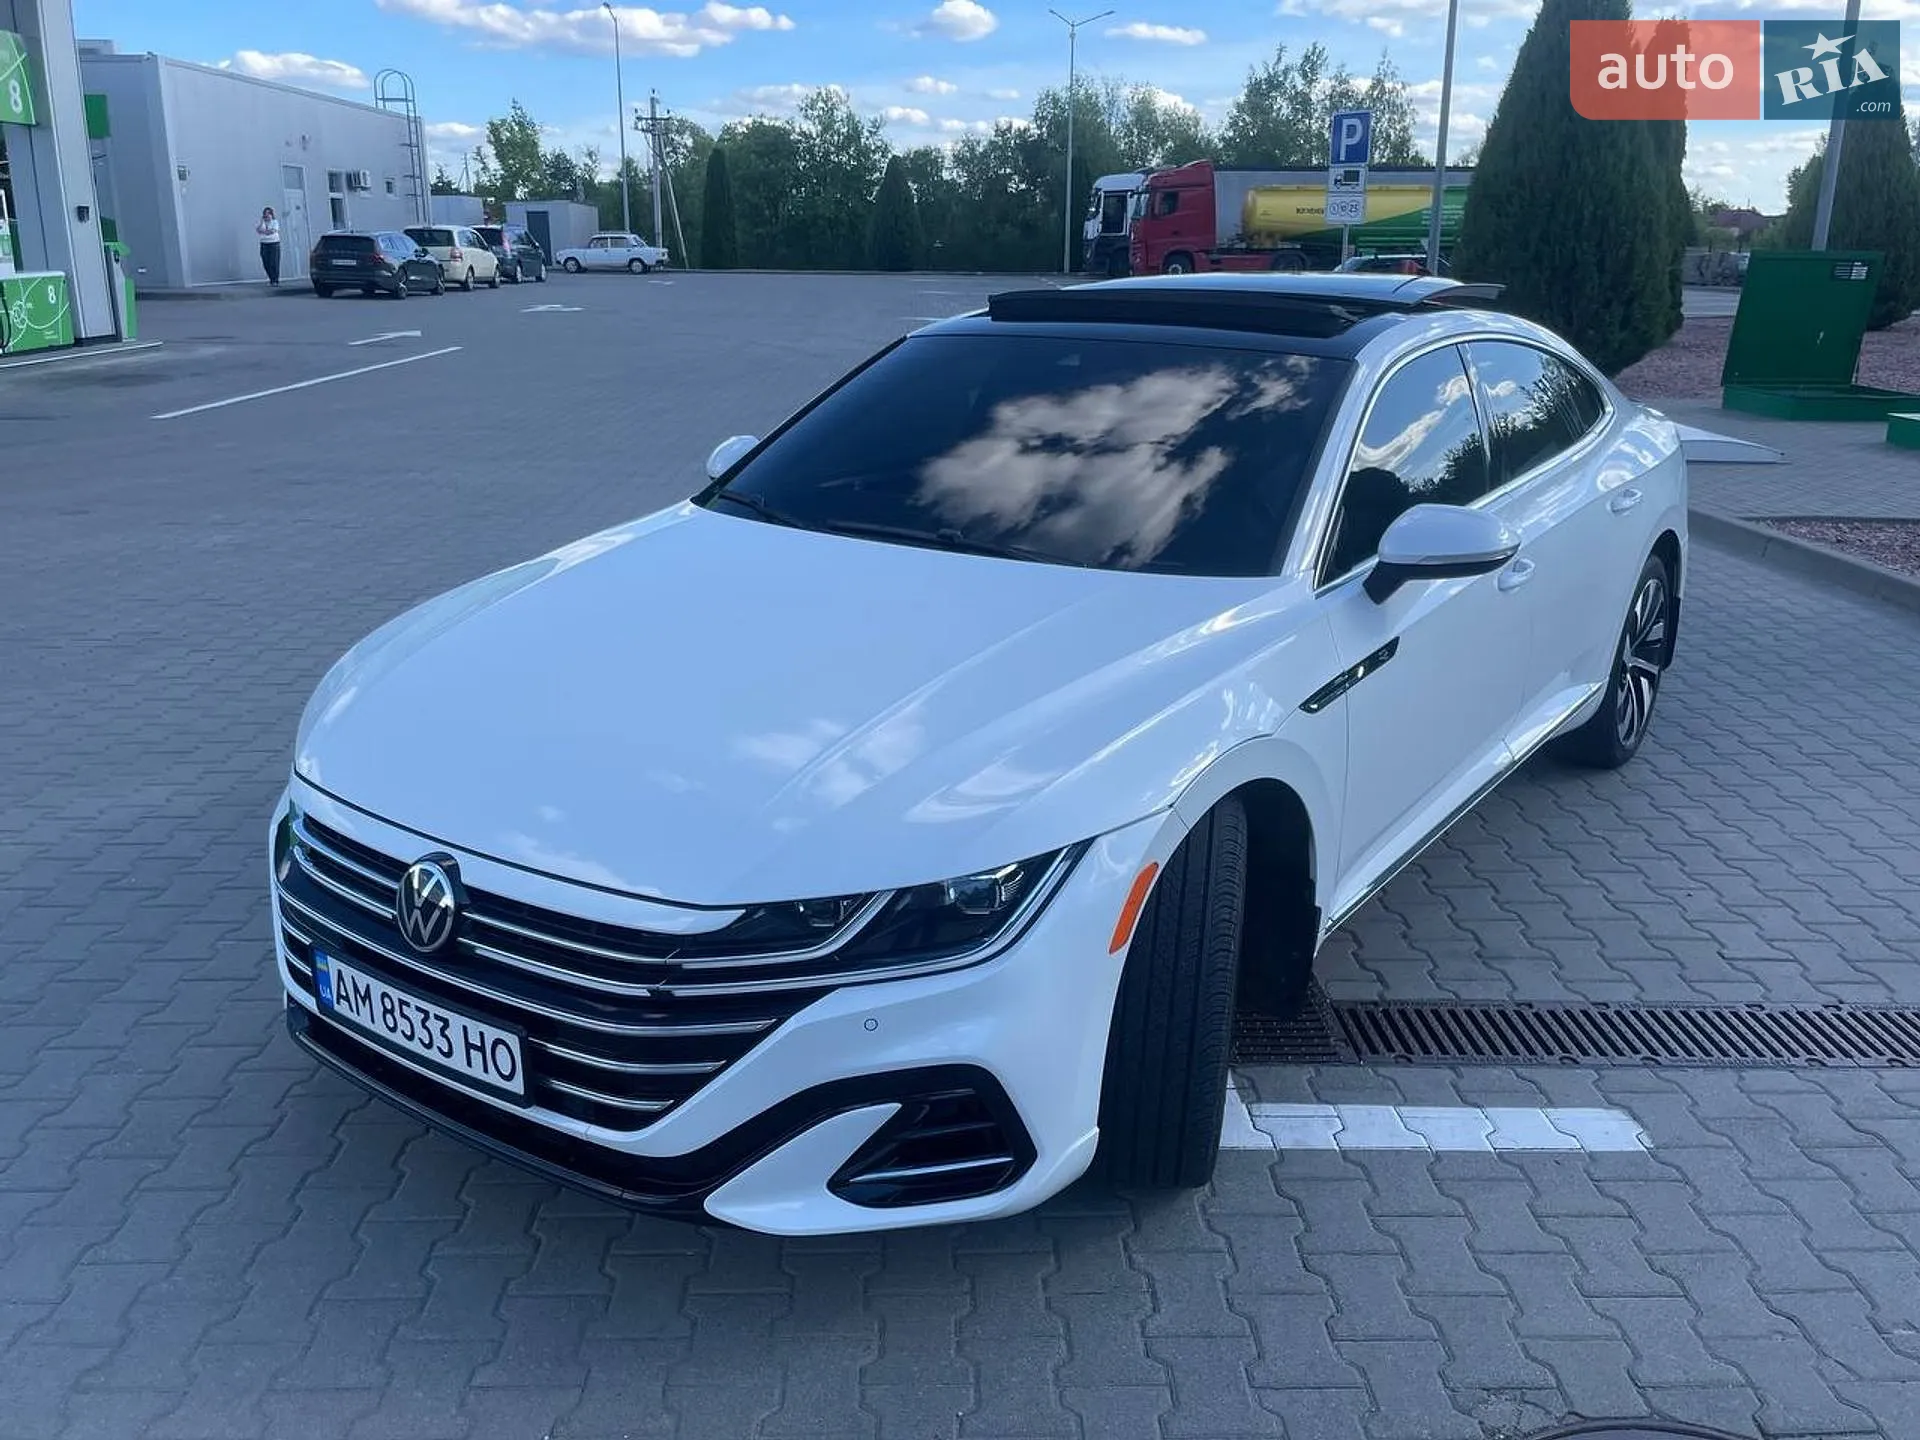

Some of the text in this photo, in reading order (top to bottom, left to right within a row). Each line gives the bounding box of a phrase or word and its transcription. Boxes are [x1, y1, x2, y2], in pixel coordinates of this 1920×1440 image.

[9, 79, 23, 114] 8
[1339, 118, 1363, 161] P
[48, 285, 56, 304] 8
[336, 969, 516, 1082] AM 8533 HO
